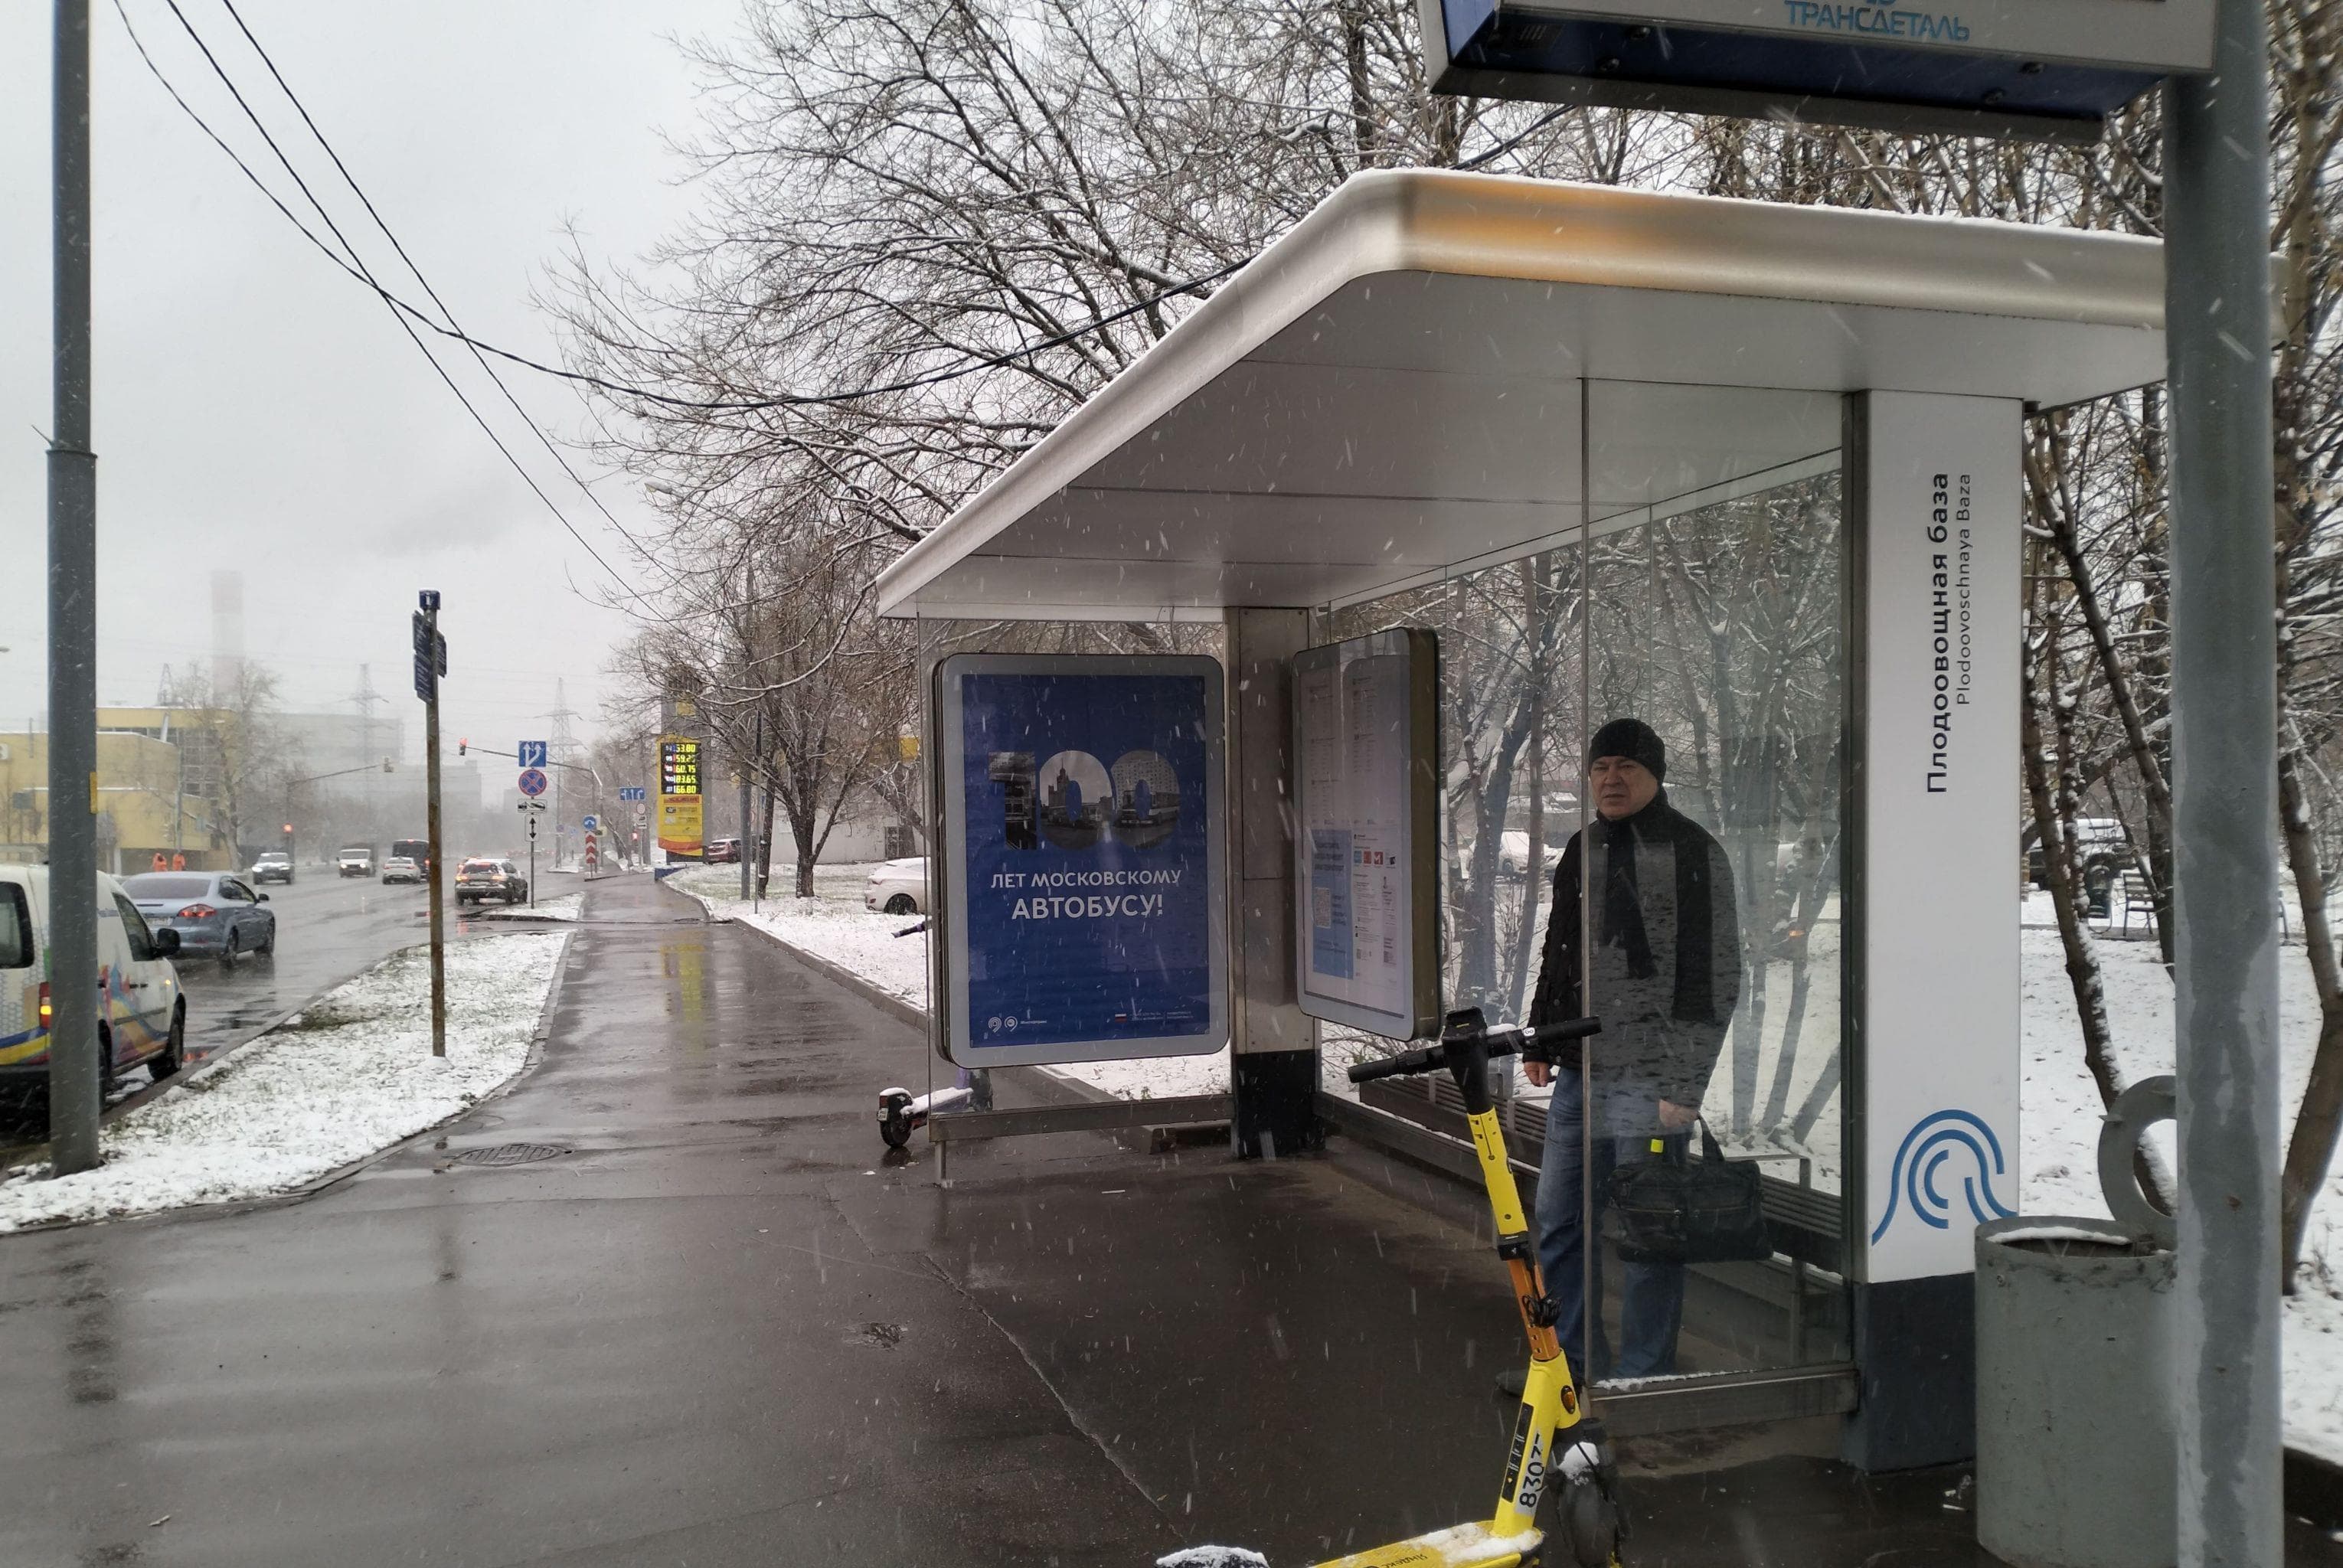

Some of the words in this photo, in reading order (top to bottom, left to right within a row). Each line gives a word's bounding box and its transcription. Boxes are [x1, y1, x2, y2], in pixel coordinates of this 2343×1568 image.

[1784, 1, 1971, 41] ТРАНСДЕТАЛЬ
[1927, 474, 1948, 543] база
[1956, 475, 1970, 521] Baza
[1956, 528, 1973, 705] Plodoovoschnaya
[1927, 554, 1951, 793] Плодоовощная
[989, 750, 1180, 850] 100
[991, 873, 1027, 889] ЛЕТ
[1031, 869, 1181, 888] МОСКОВСКОМУ
[1011, 893, 1163, 920] АВТОБУСУ!
